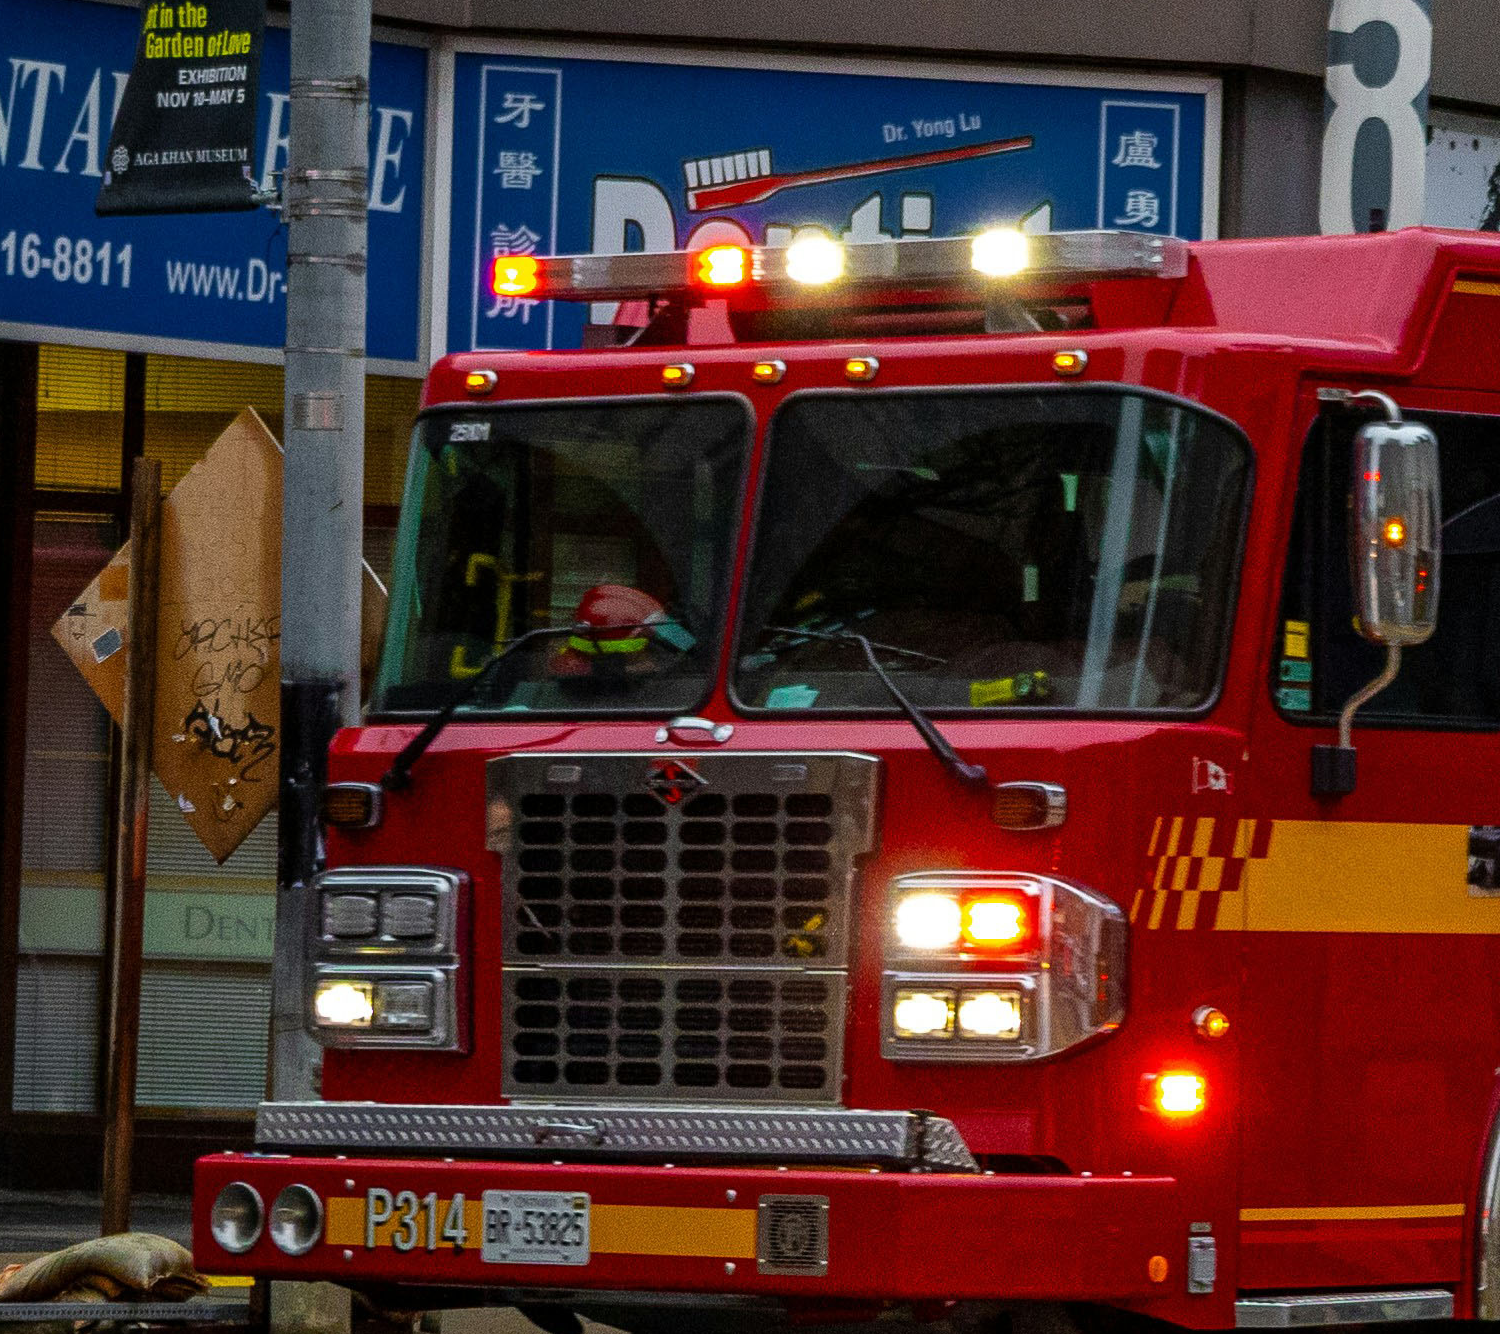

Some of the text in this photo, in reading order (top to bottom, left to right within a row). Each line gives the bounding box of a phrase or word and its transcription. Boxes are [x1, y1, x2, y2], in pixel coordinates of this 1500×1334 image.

[160, 0, 174, 28] in
[177, 0, 208, 29] the
[145, 29, 252, 59] Garden of Love
[178, 65, 248, 86] EXHIBITION
[156, 91, 191, 108] NOV
[236, 88, 246, 105] 5
[882, 111, 982, 144] Dr. Yong Lu
[133, 147, 249, 167] AGA KHAN MUSEUM
[166, 258, 289, 306] www.Dr-
[184, 905, 277, 943] DENT
[366, 1186, 468, 1253] P314
